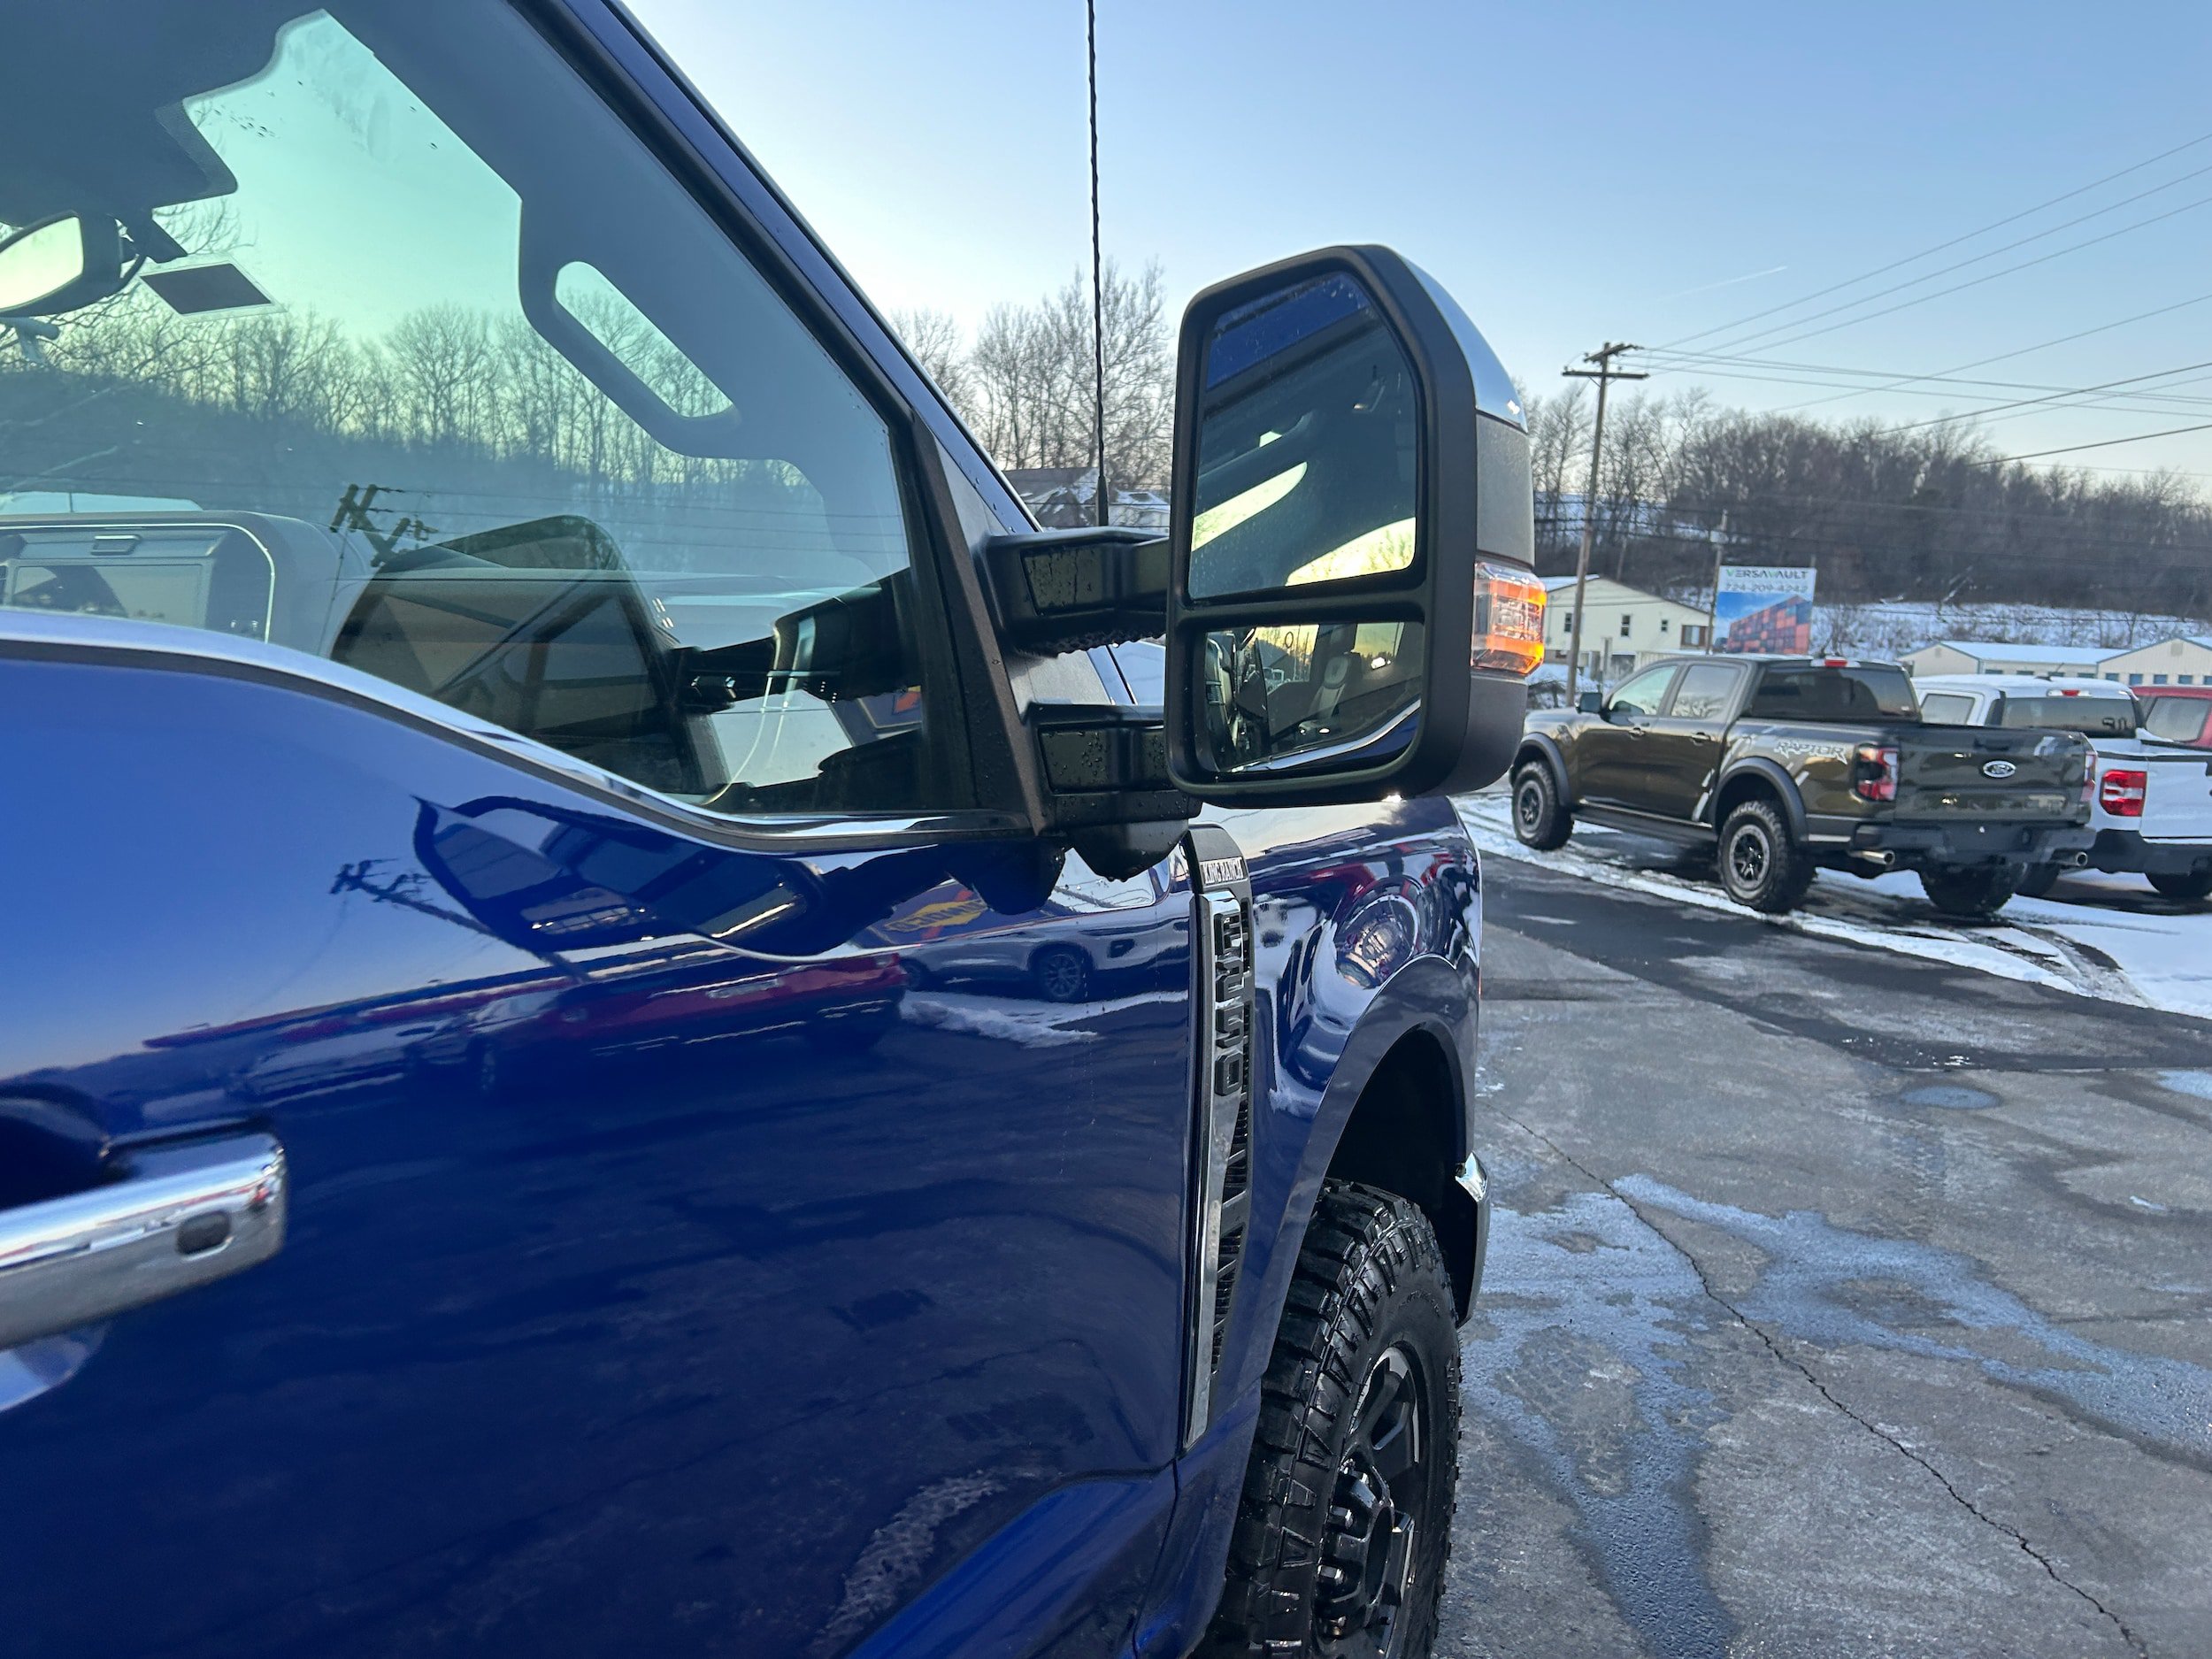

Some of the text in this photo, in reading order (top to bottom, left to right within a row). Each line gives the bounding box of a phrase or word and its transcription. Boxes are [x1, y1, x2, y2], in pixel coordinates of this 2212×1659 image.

[1726, 569, 1809, 580] VERSAVAULT
[1774, 741, 1847, 764] RAPTOR
[1203, 857, 1243, 883] KING RANCH
